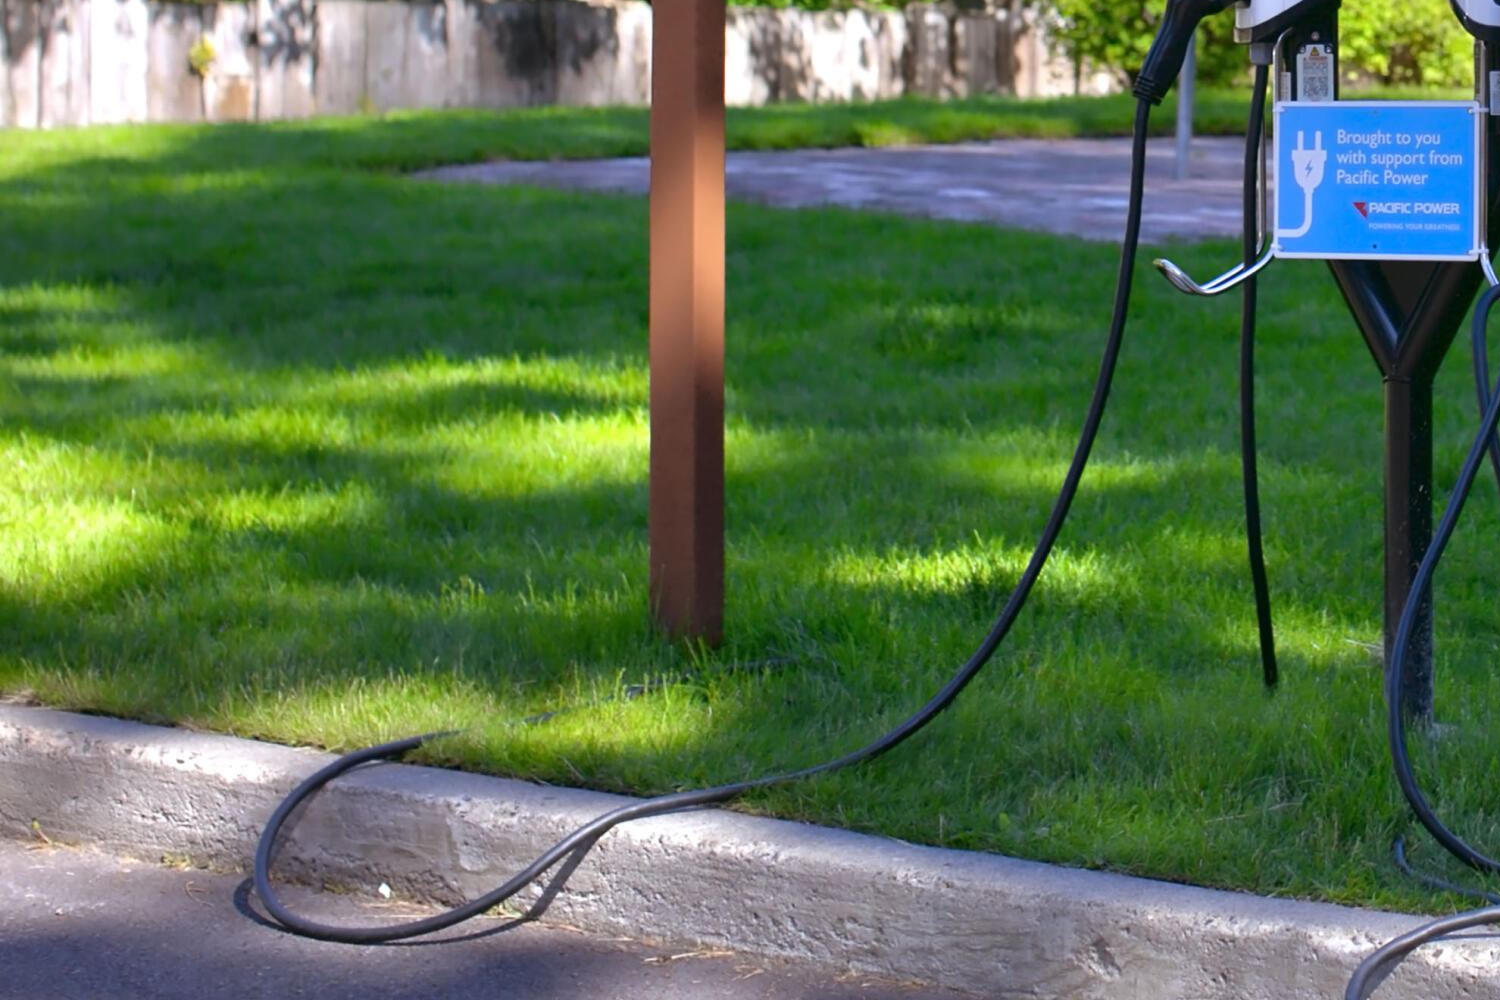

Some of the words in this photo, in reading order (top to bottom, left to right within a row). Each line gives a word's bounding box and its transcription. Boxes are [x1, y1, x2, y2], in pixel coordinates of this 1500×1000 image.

[1336, 129, 1392, 149] Brought
[1396, 131, 1411, 145] to
[1415, 134, 1441, 149] you
[1336, 150, 1366, 165] with
[1371, 152, 1425, 169] support
[1429, 149, 1463, 166] from
[1336, 169, 1379, 185] Pacific
[1383, 169, 1429, 185] Power
[1368, 202, 1412, 214] PACIFIC
[1414, 202, 1460, 215] POWER
